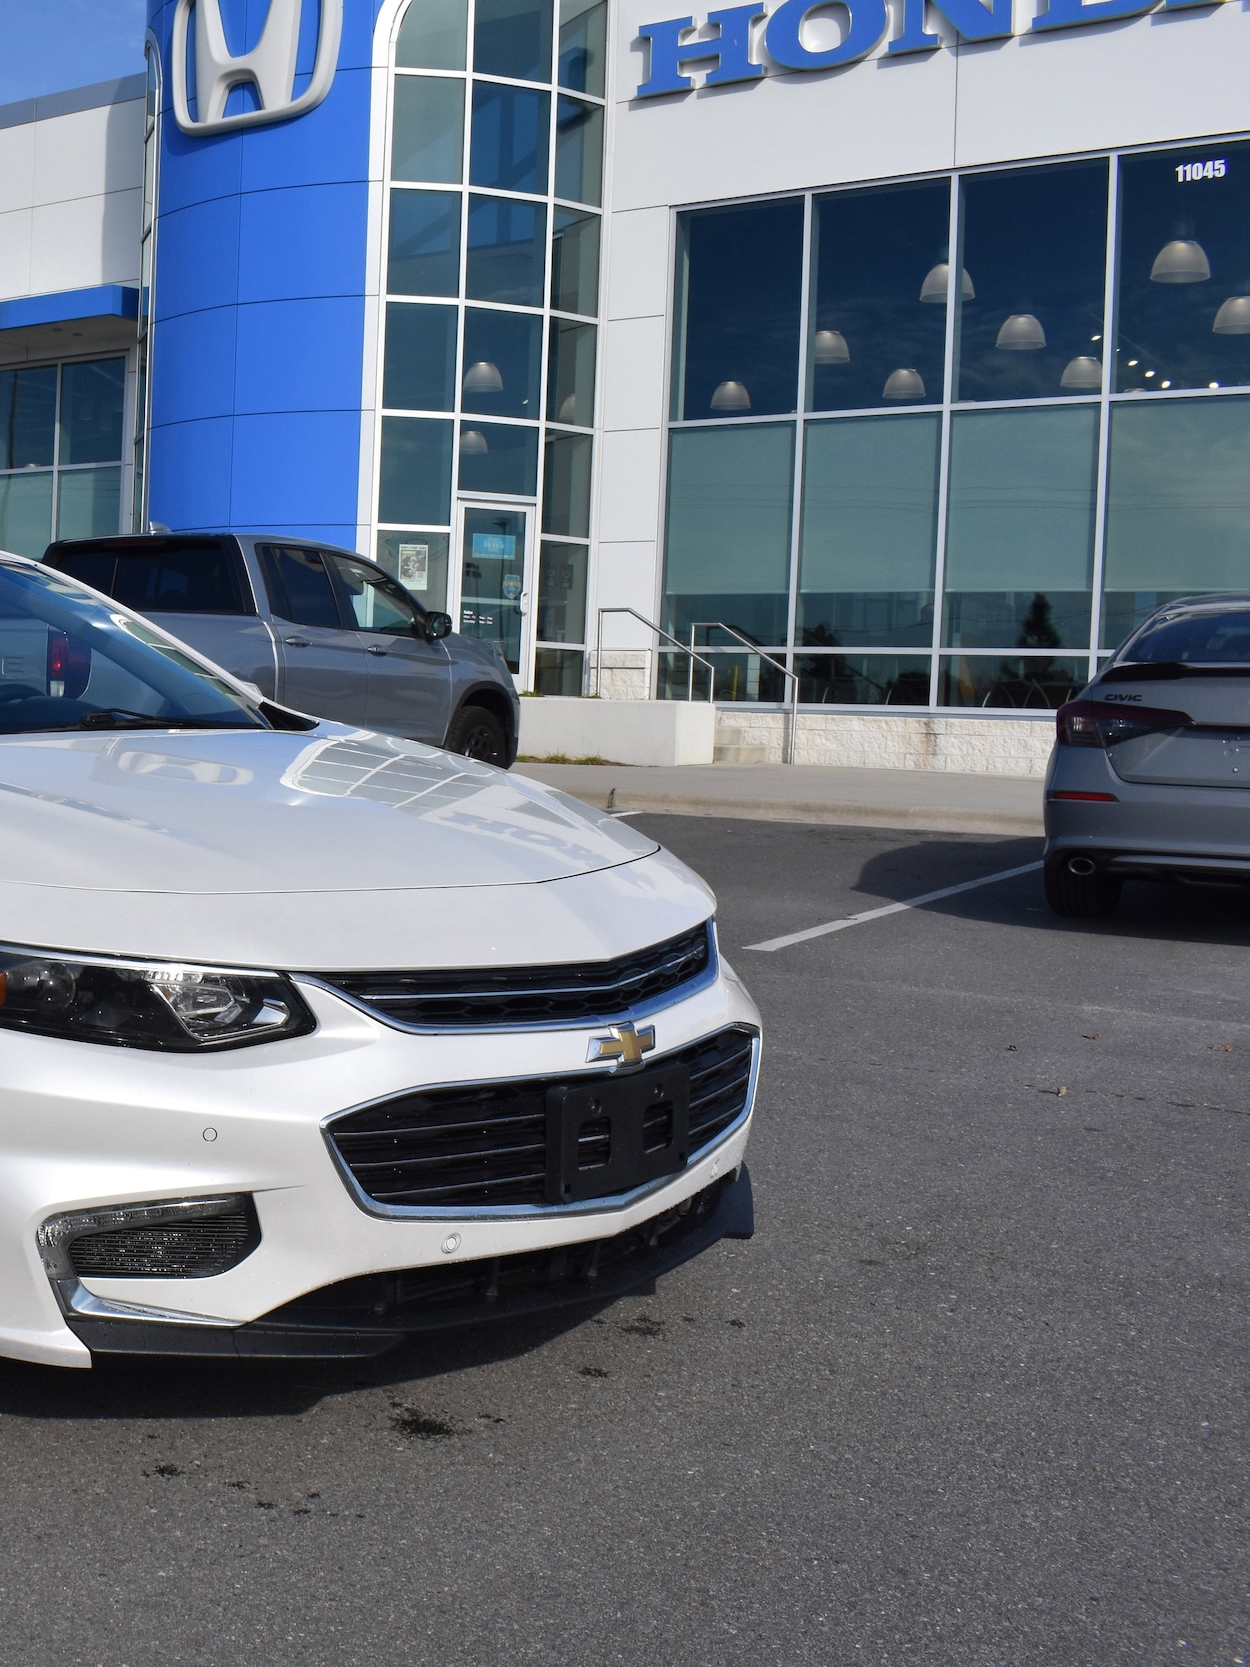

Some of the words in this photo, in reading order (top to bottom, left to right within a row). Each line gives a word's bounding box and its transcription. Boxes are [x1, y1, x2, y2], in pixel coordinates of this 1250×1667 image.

[633, 0, 1228, 95] HON
[1175, 159, 1226, 183] 11045
[1105, 694, 1143, 702] CIVIC
